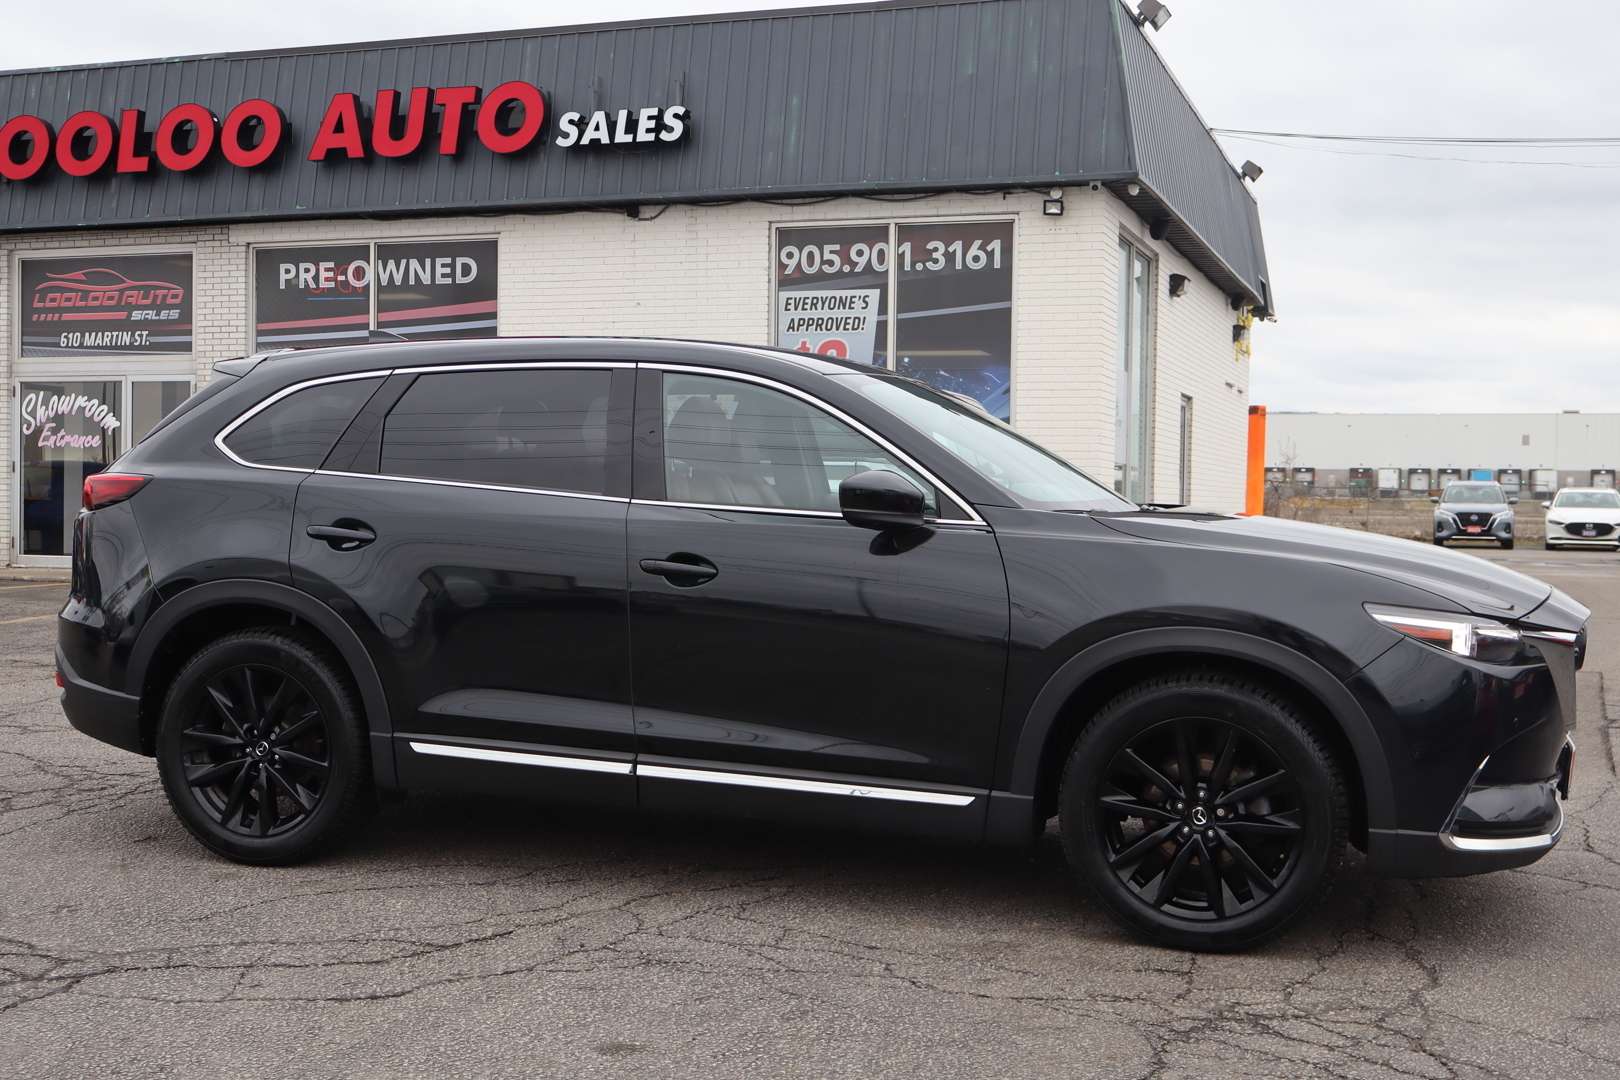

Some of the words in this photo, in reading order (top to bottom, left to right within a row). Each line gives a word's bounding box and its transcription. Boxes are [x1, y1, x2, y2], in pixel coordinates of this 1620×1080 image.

[0, 99, 282, 180] OOLOO
[307, 81, 545, 161] AUTO
[555, 105, 687, 148] SALES
[780, 239, 1001, 275] 905.901.3161
[280, 257, 478, 289] PRE-OWNED
[32, 291, 120, 308] LOOLOO
[122, 289, 184, 305] AUTO
[784, 295, 870, 311] EVERYONE'S
[131, 309, 180, 320] SALES
[786, 316, 866, 332] APPROVED!
[60, 332, 81, 347] 610
[83, 331, 131, 347] MARTIN
[134, 331, 150, 346] ST.
[21, 391, 120, 435] Showroom
[38, 423, 101, 448] Entrance
